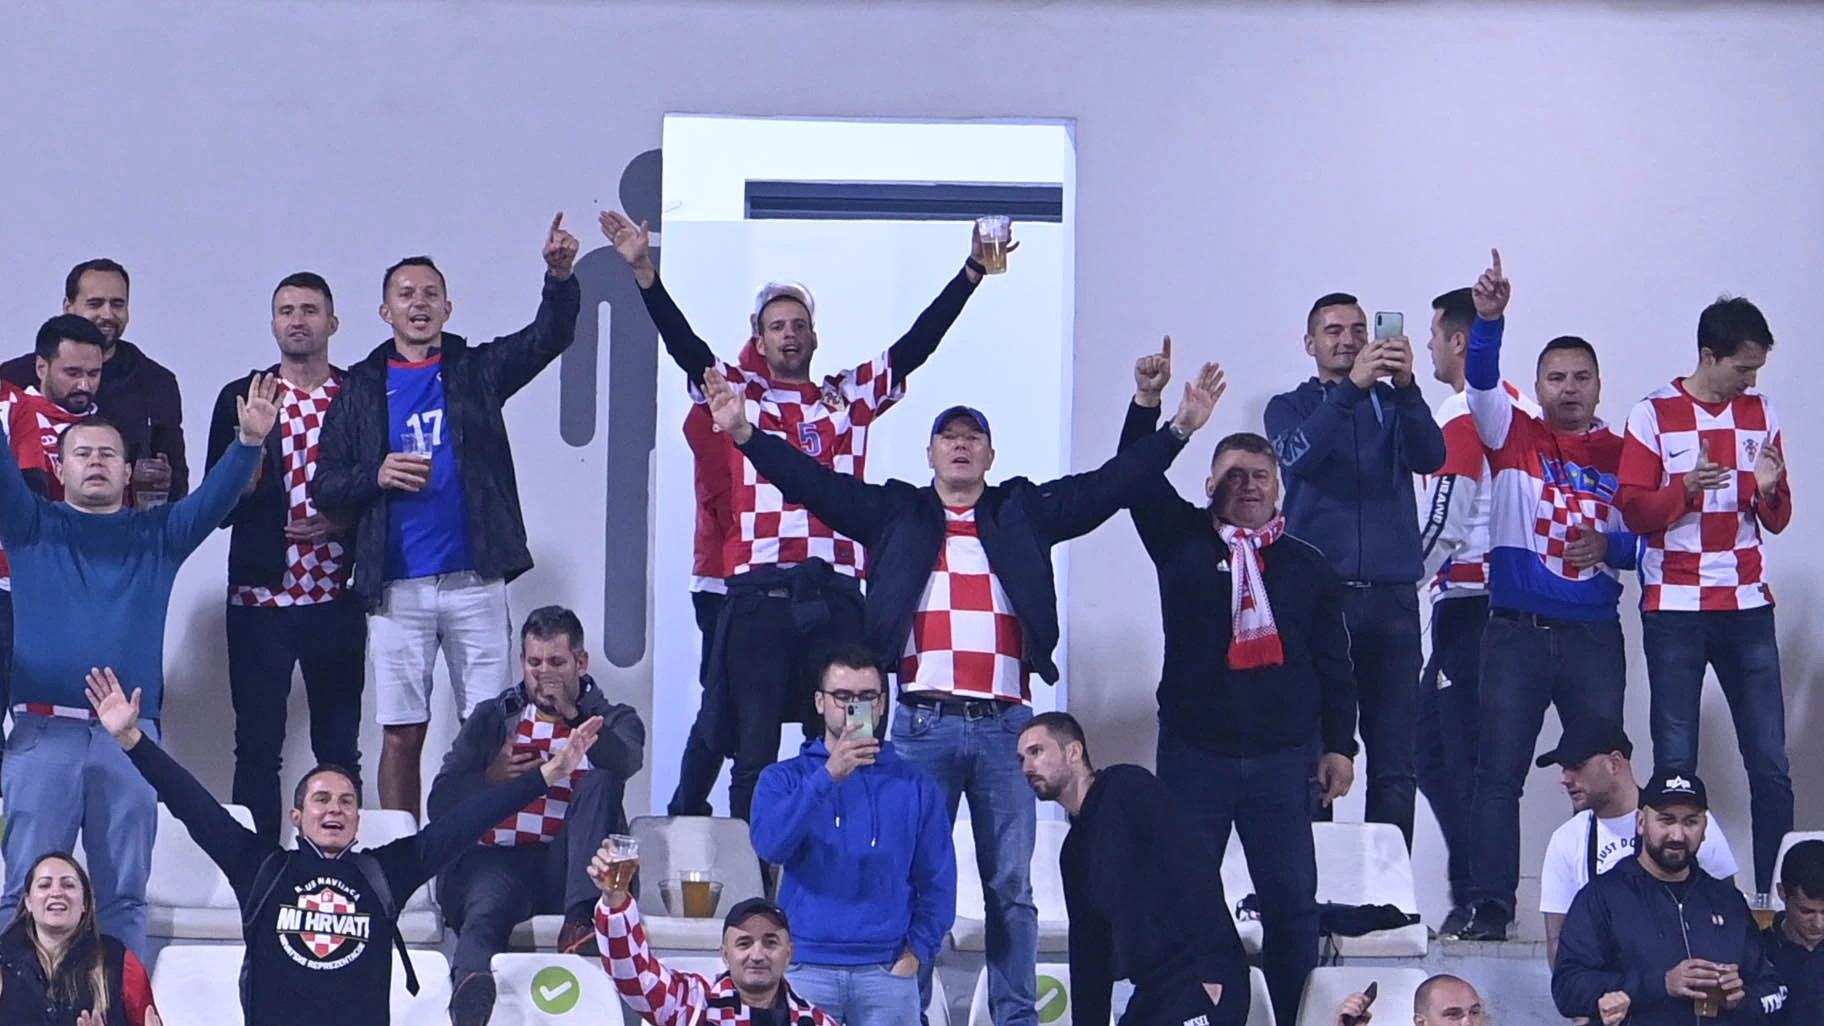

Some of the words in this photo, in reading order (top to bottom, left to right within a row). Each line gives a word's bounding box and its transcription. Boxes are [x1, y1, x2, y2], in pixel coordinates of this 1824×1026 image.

[406, 408, 443, 451] 17
[797, 422, 822, 457] 5
[1597, 842, 1618, 865] JUST
[276, 906, 303, 931] MI
[304, 911, 371, 939] HRVATI
